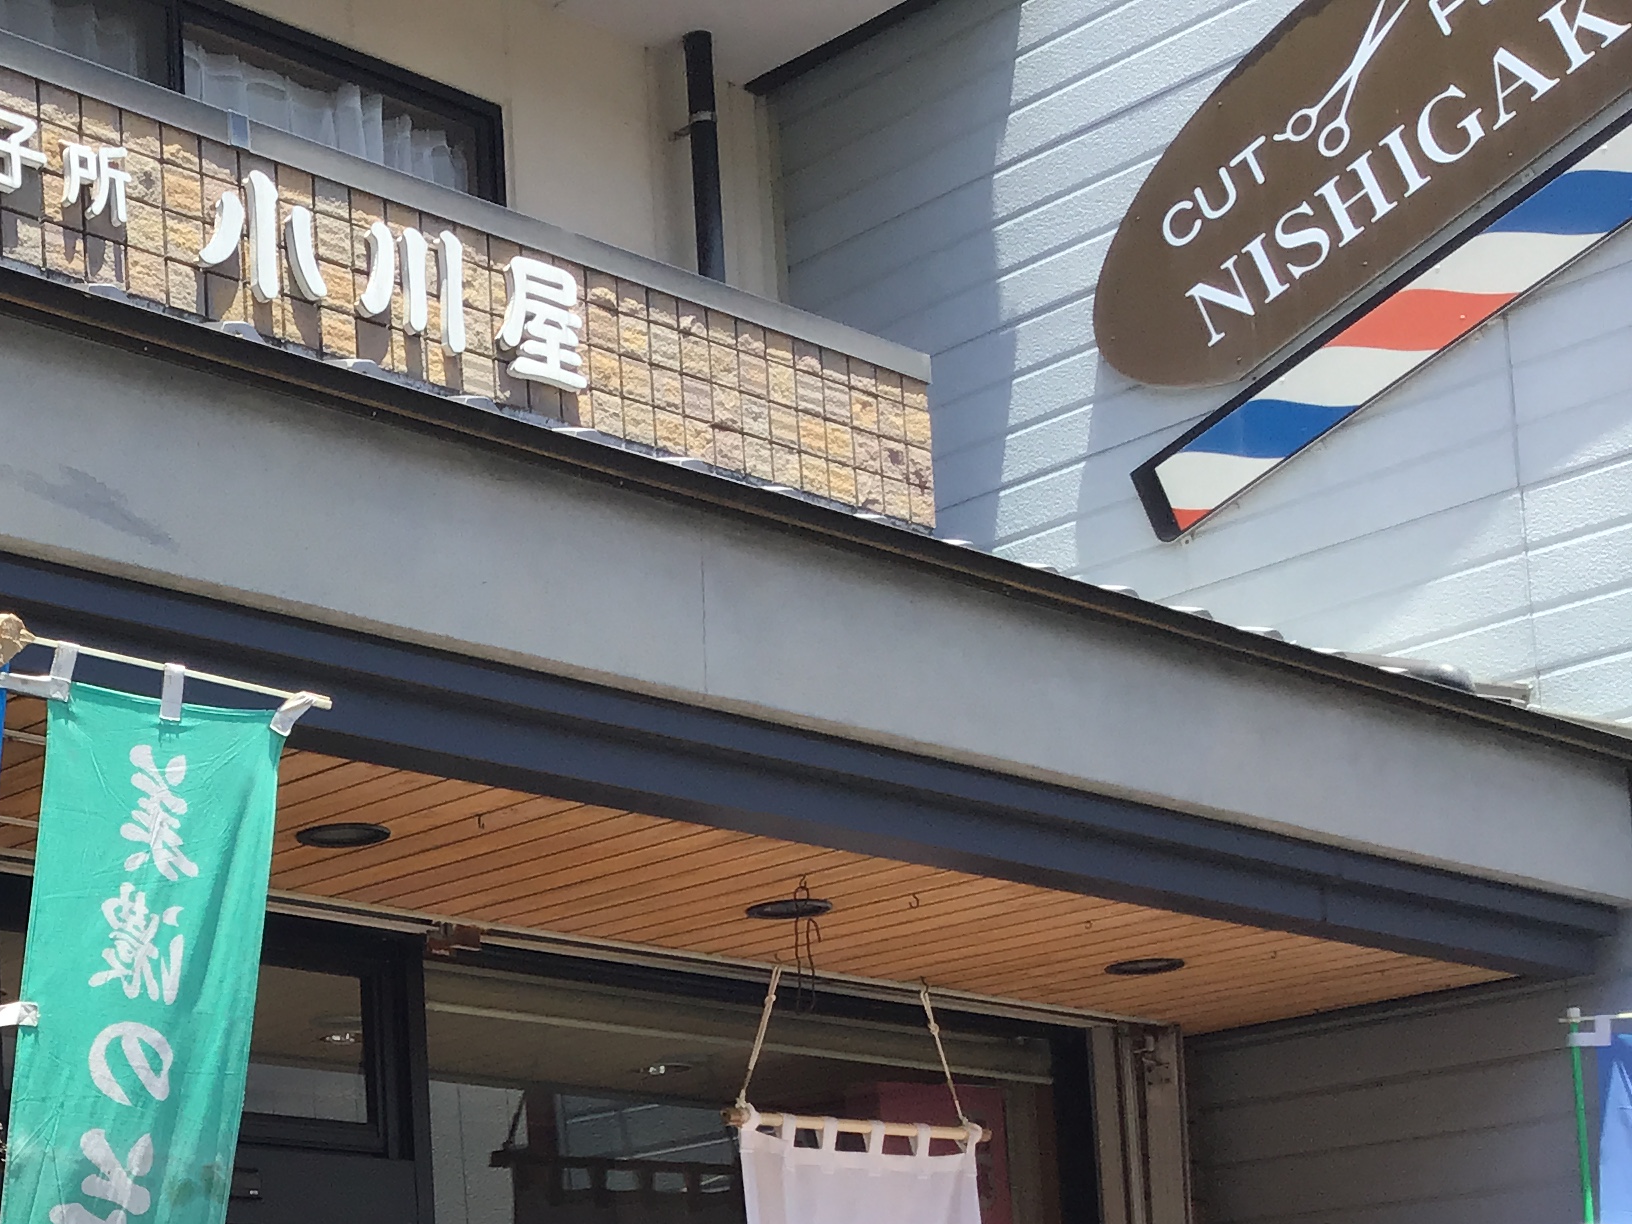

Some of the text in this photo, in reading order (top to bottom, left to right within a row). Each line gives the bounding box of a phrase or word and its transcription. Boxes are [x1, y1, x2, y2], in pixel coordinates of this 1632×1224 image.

[198, 169, 589, 393] 小川屋
[1162, 136, 1267, 247] CUT
[1185, 0, 1632, 348] NISHIGAK
